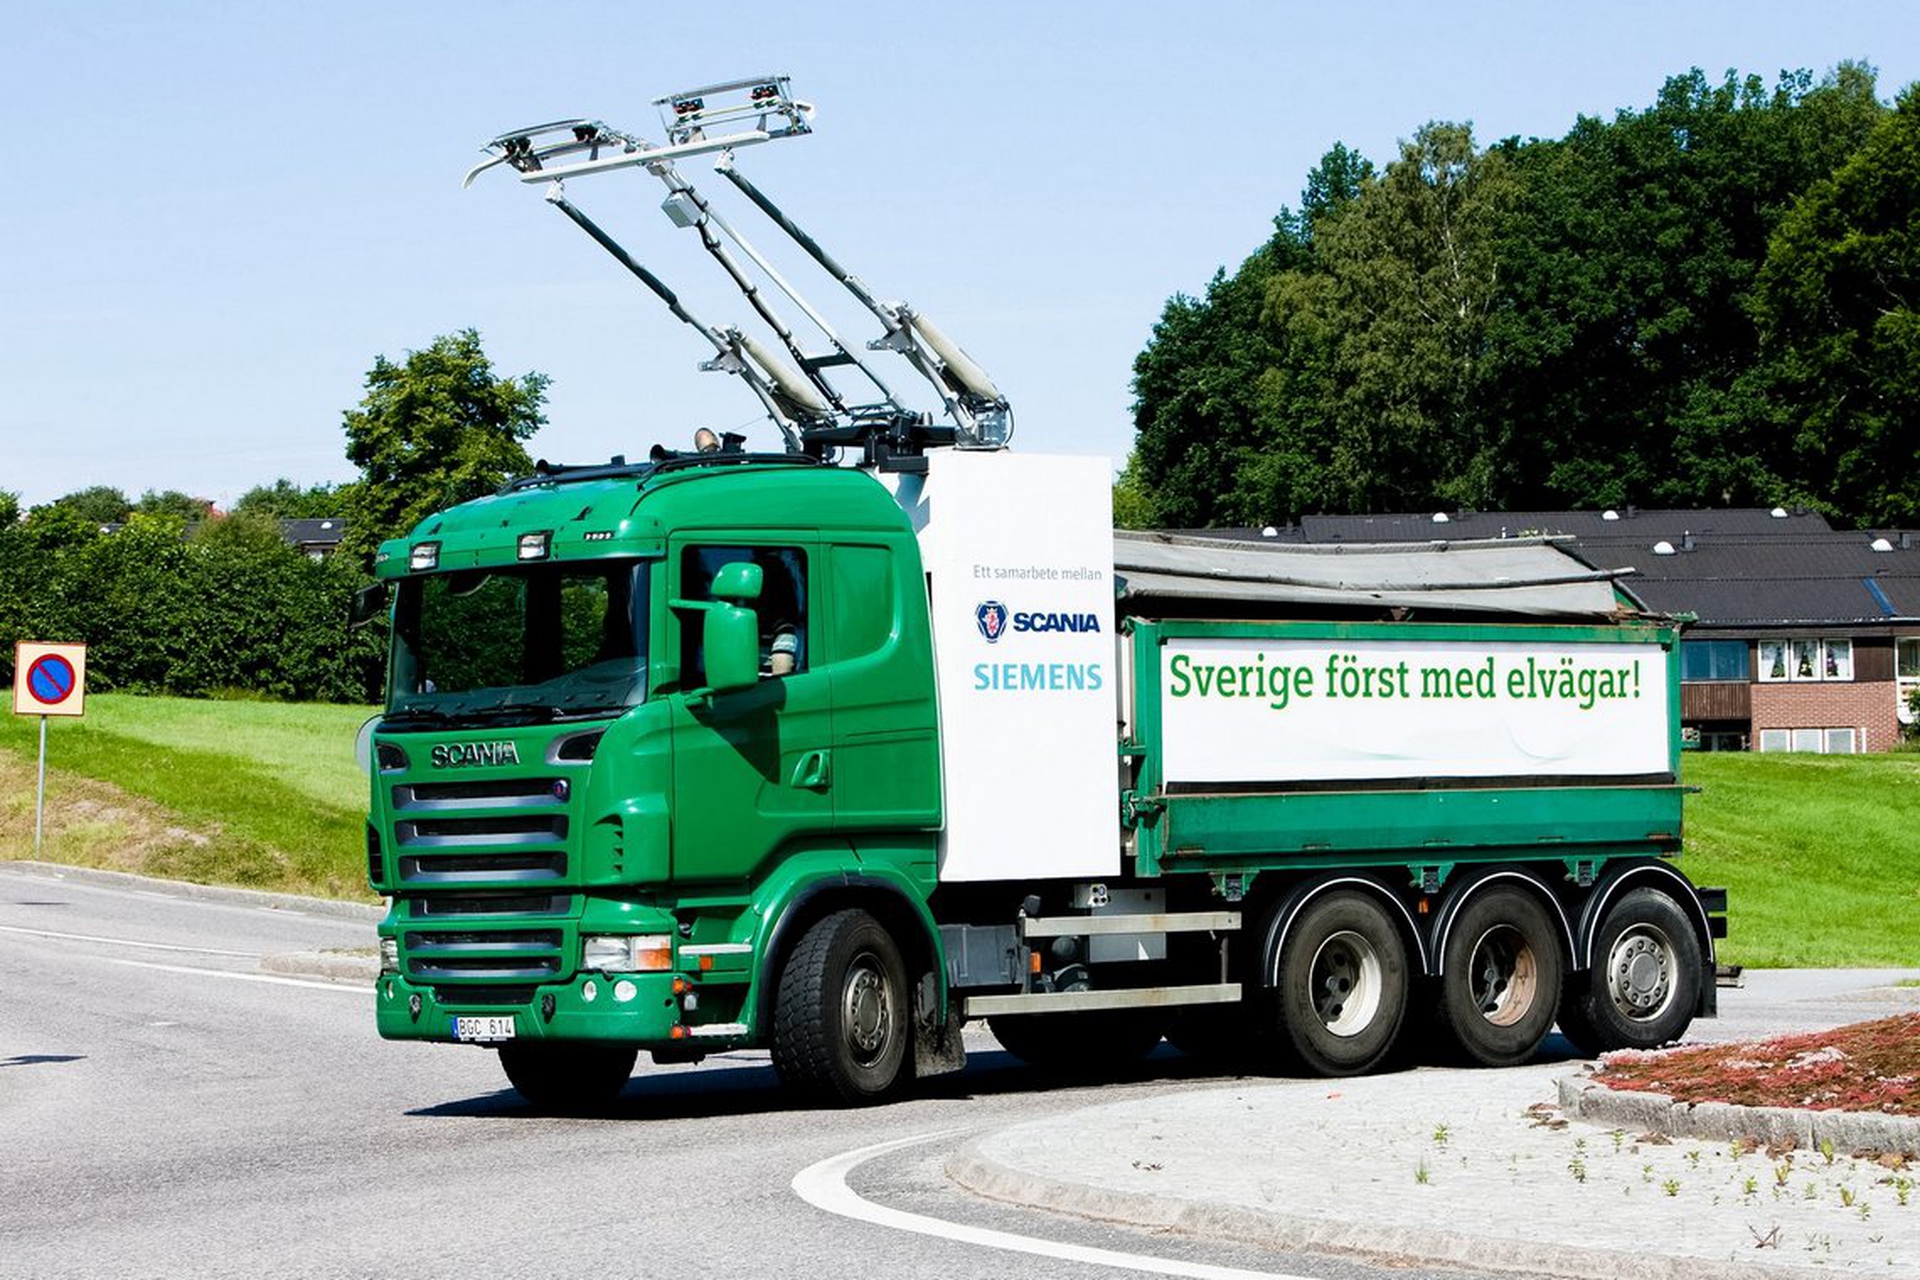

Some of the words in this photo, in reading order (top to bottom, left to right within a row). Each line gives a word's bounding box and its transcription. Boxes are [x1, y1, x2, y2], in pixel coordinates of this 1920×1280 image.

[973, 564, 992, 579] Ett
[994, 565, 1059, 580] samarbete
[1061, 566, 1103, 580] mellan
[1013, 612, 1101, 633] SCANIA
[974, 663, 1103, 691] SIEMENS
[1169, 653, 1314, 709] Sverige
[1326, 654, 1410, 699] först
[1420, 657, 1497, 699] med
[1507, 657, 1641, 709] elvägar!
[431, 741, 520, 769] SCANIA
[459, 1018, 482, 1036] BGC
[489, 1018, 511, 1035] 614
